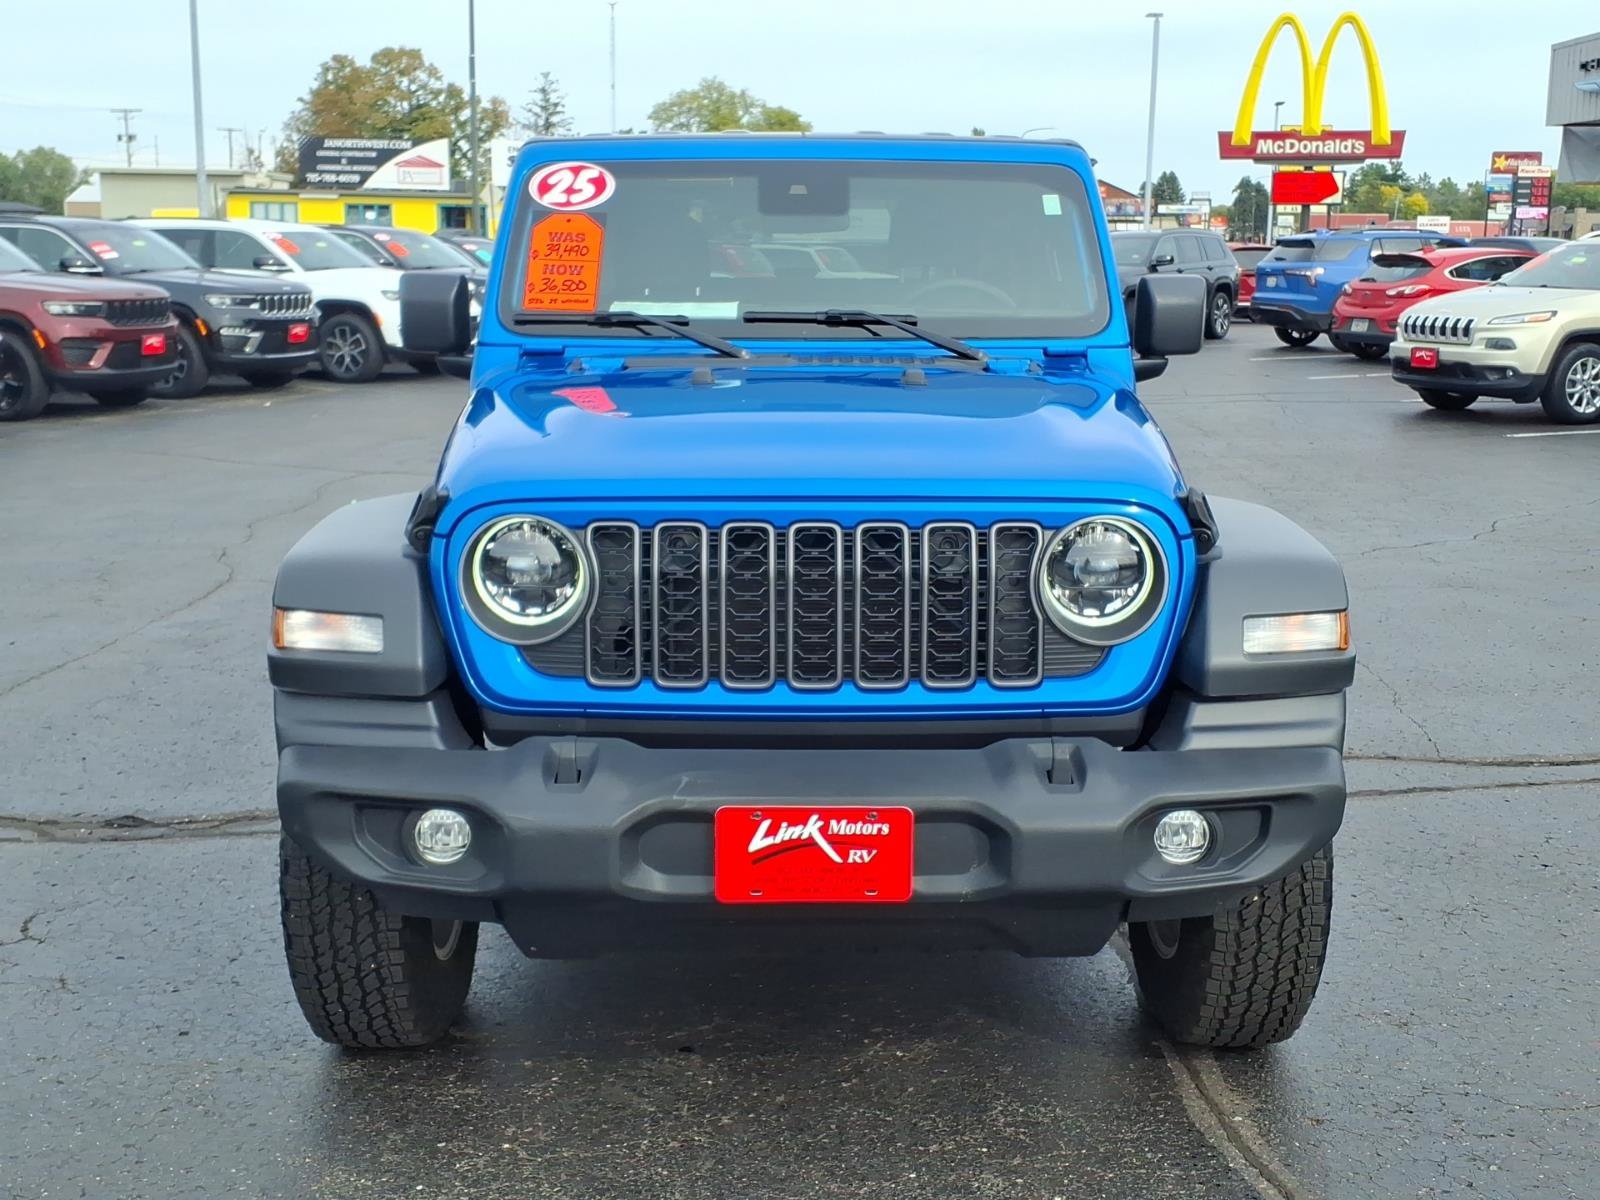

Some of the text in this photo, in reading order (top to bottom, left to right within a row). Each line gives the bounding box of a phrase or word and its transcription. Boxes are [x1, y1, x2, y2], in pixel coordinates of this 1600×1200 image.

[1256, 138, 1365, 154] McDonald's
[541, 168, 601, 204] 25
[548, 231, 586, 243] WAS
[544, 243, 590, 259] 39,490
[542, 264, 585, 276] NOW
[539, 277, 588, 294] 36,500
[748, 814, 890, 864] Link Motors
[847, 850, 878, 864] RV
